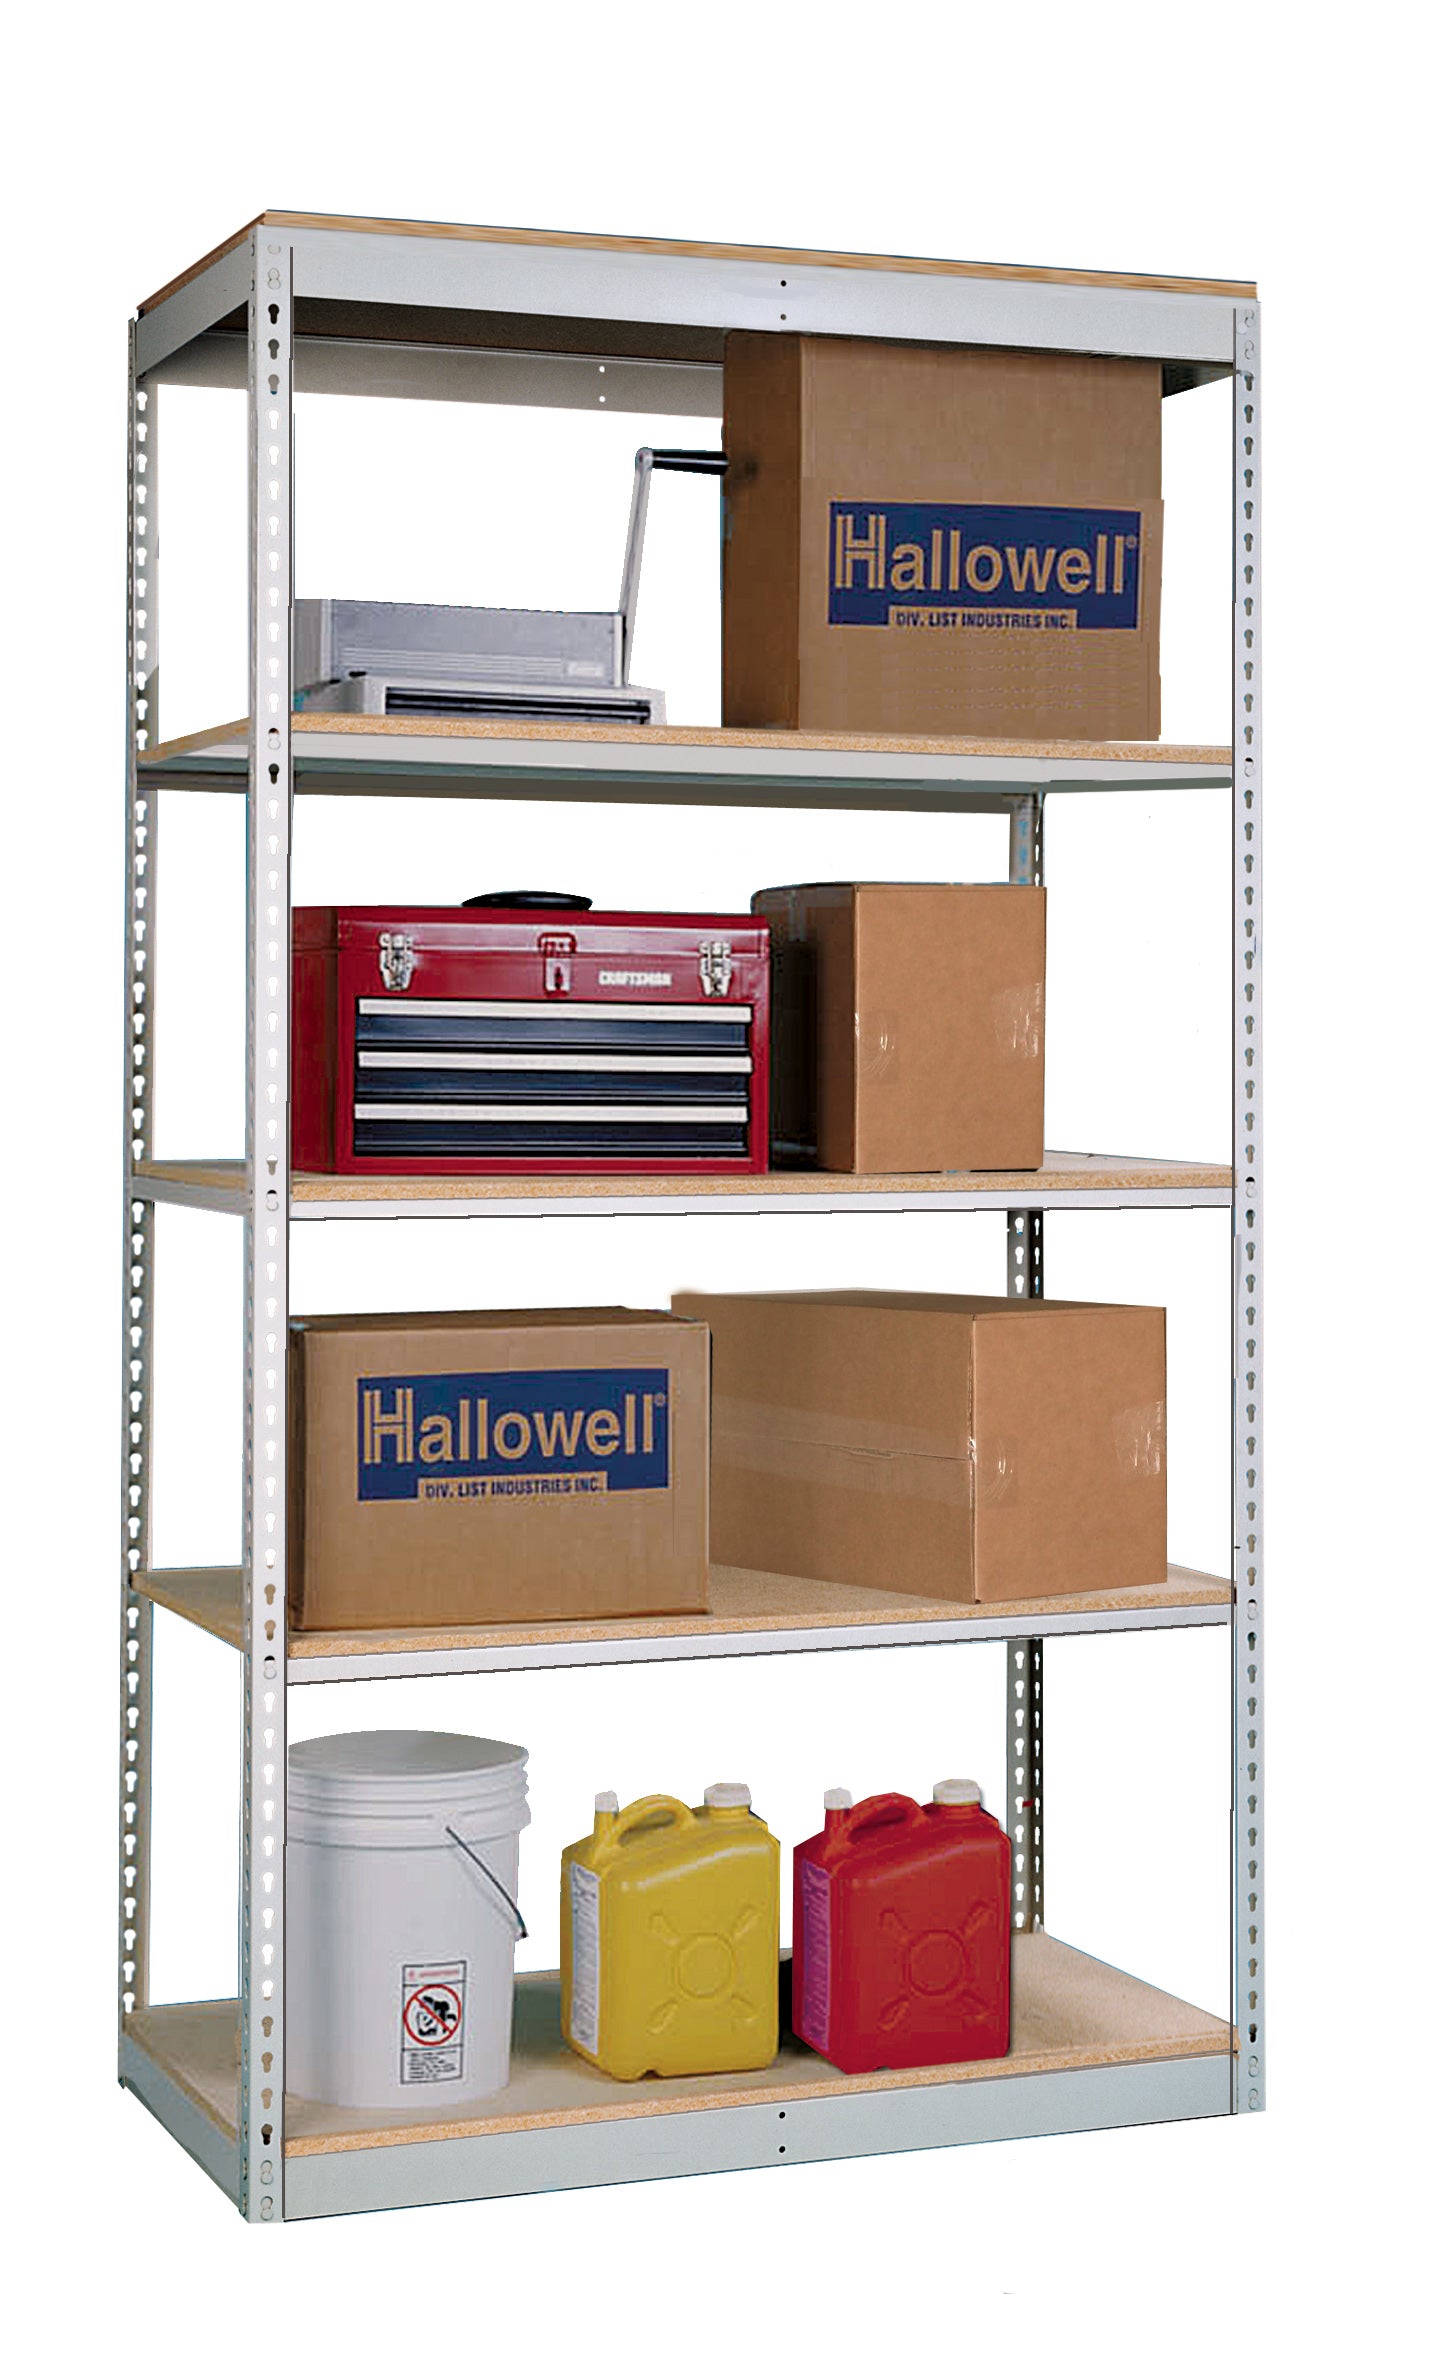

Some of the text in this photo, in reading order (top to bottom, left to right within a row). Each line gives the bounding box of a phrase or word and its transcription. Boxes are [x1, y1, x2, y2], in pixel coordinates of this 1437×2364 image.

[834, 513, 1124, 595] Hallowell
[896, 611, 1074, 630] DIV. LIST INDUSTRIES INC.
[363, 1387, 654, 1465] Hallowell
[425, 1477, 603, 1499] DIV. LIST INDUSTRIES INC.
